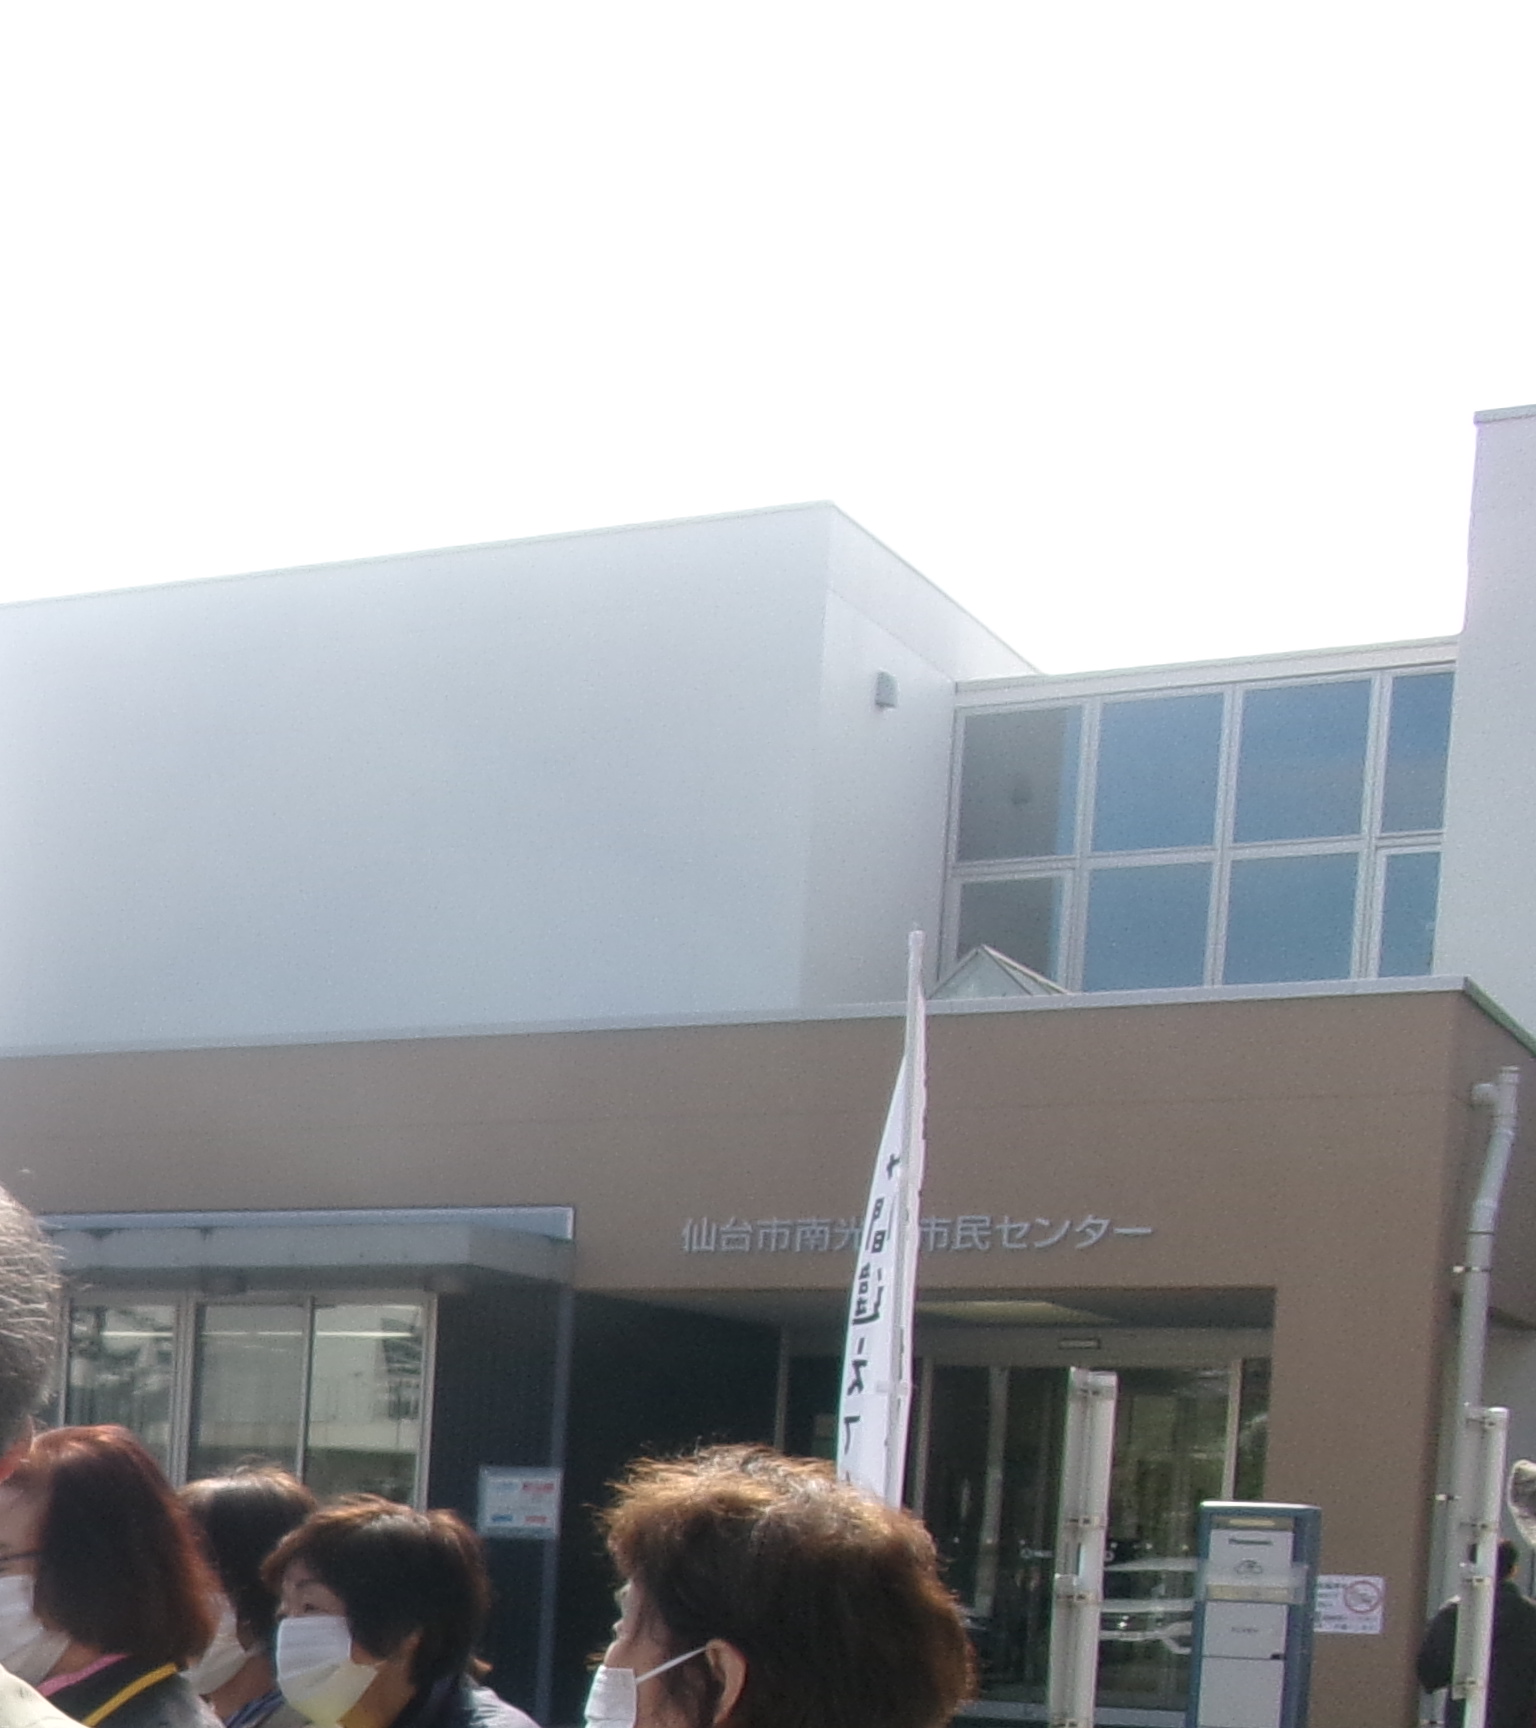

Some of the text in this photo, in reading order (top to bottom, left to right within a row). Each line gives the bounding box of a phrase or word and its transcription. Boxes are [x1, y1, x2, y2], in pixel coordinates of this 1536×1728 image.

[681, 1214, 1153, 1254] 仙台市南光市民センター
